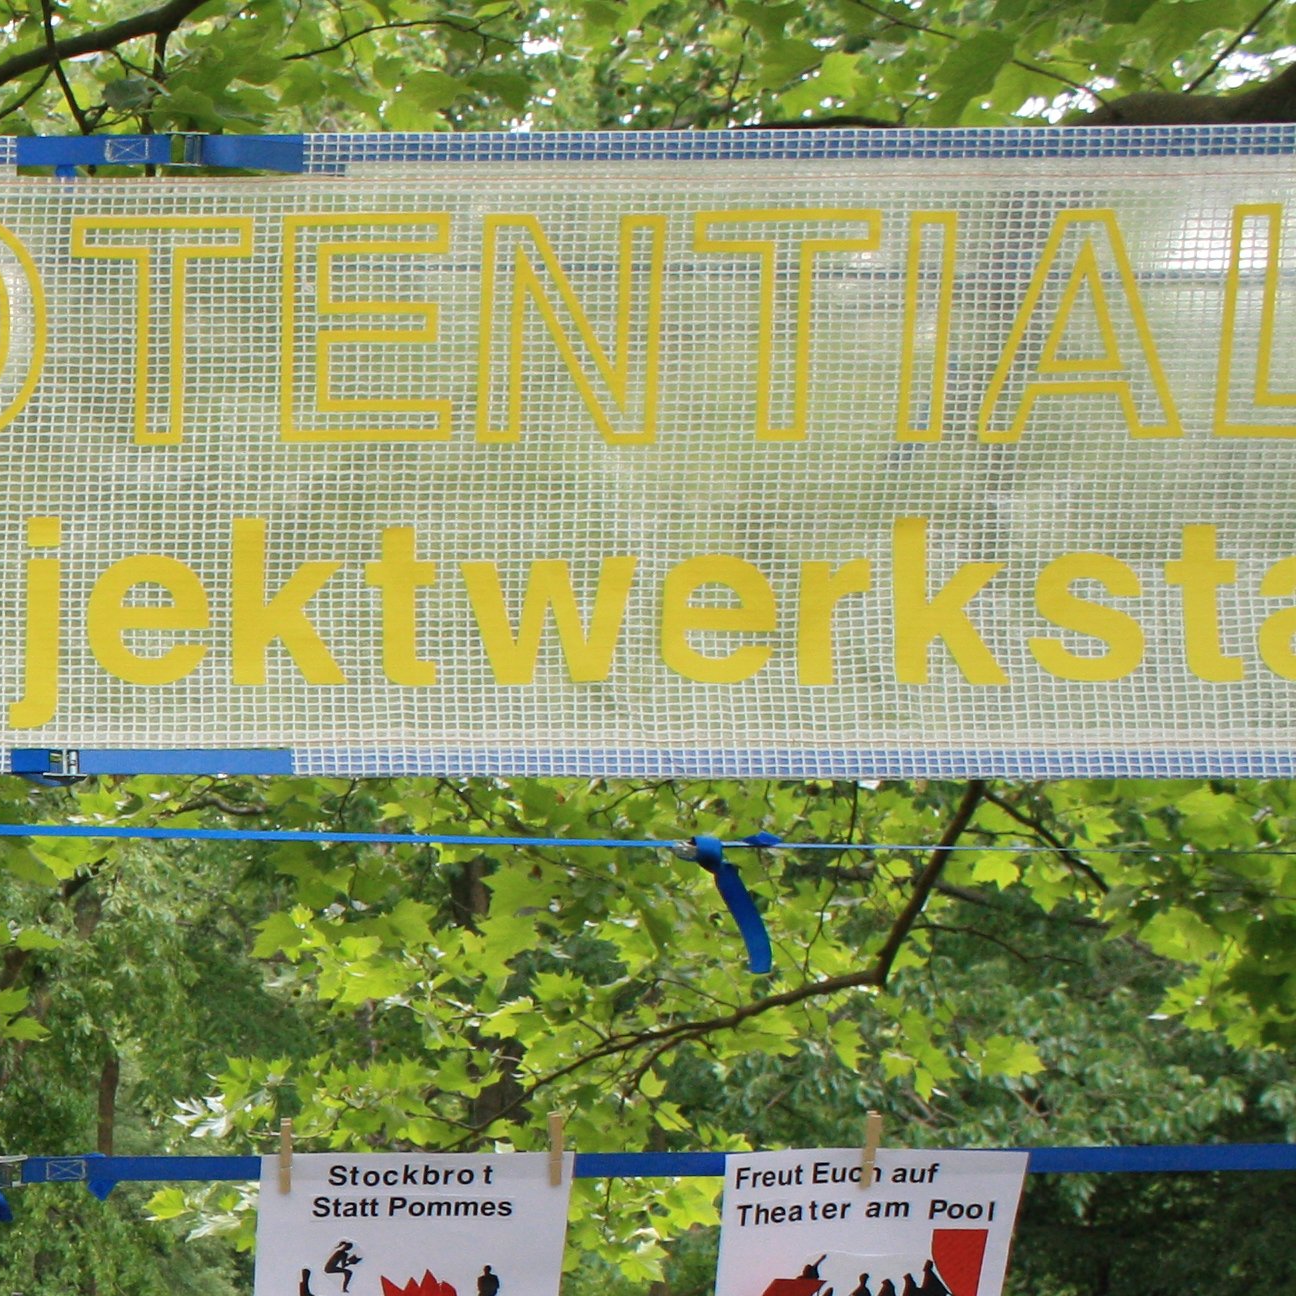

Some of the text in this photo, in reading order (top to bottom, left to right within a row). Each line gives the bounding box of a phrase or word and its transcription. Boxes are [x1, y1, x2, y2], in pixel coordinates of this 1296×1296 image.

[328, 1164, 494, 1186] Stockbrot
[735, 1165, 804, 1189] Freut
[892, 1162, 940, 1184] auf
[312, 1197, 513, 1217] Statt Pommes
[737, 1199, 995, 1226] Theater am Pool
